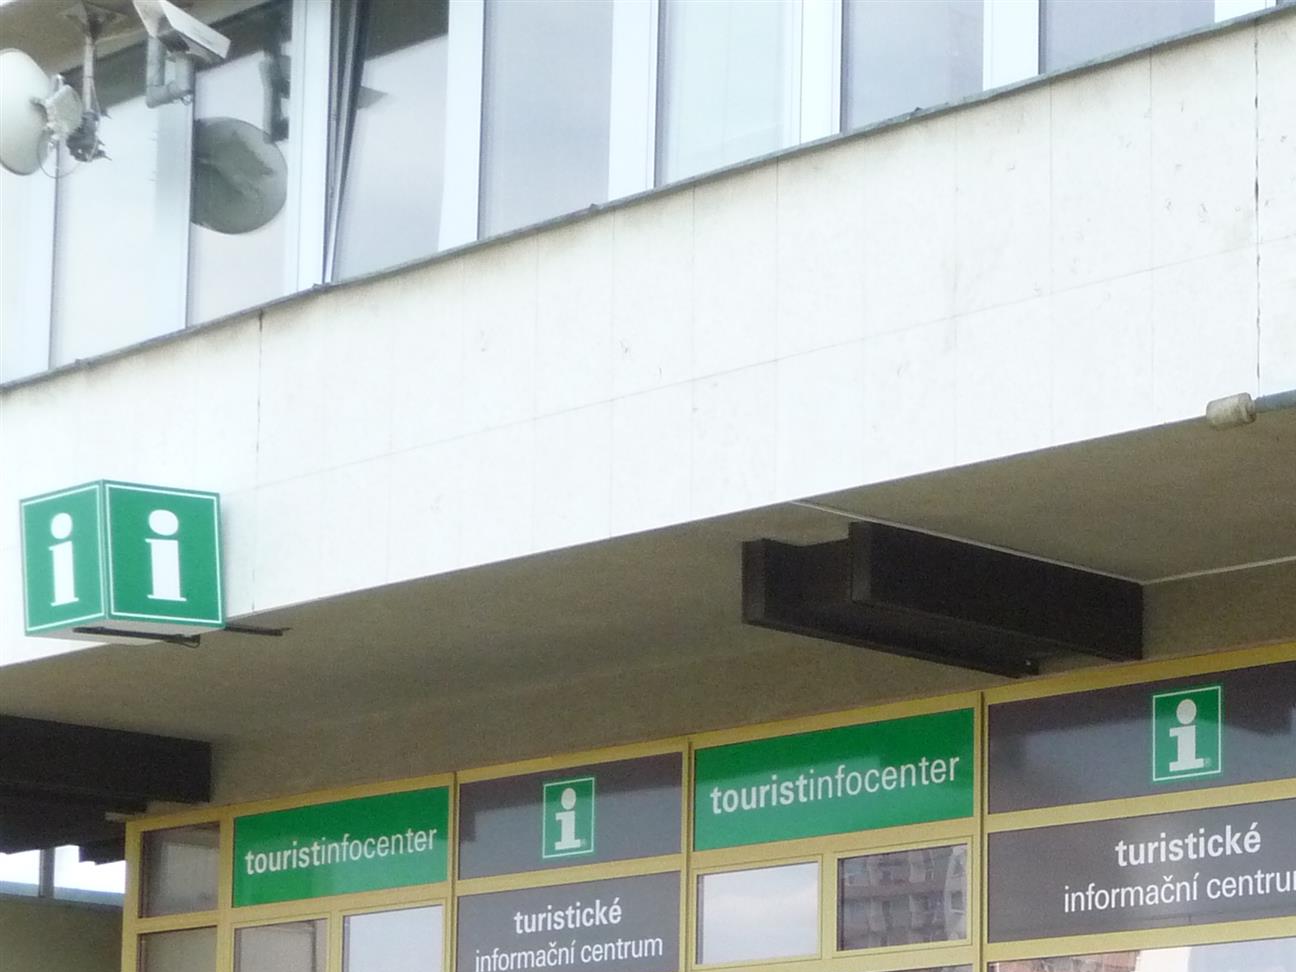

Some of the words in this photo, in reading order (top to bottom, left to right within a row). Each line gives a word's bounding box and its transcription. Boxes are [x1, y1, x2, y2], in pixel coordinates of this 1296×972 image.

[710, 756, 960, 815] touristinfocenter
[244, 828, 438, 875] touristinfocenter
[1115, 822, 1262, 867] turistické
[1064, 873, 1200, 913] informační
[514, 897, 622, 934] turistické
[475, 940, 576, 972] informační
[581, 937, 663, 962] centrum
